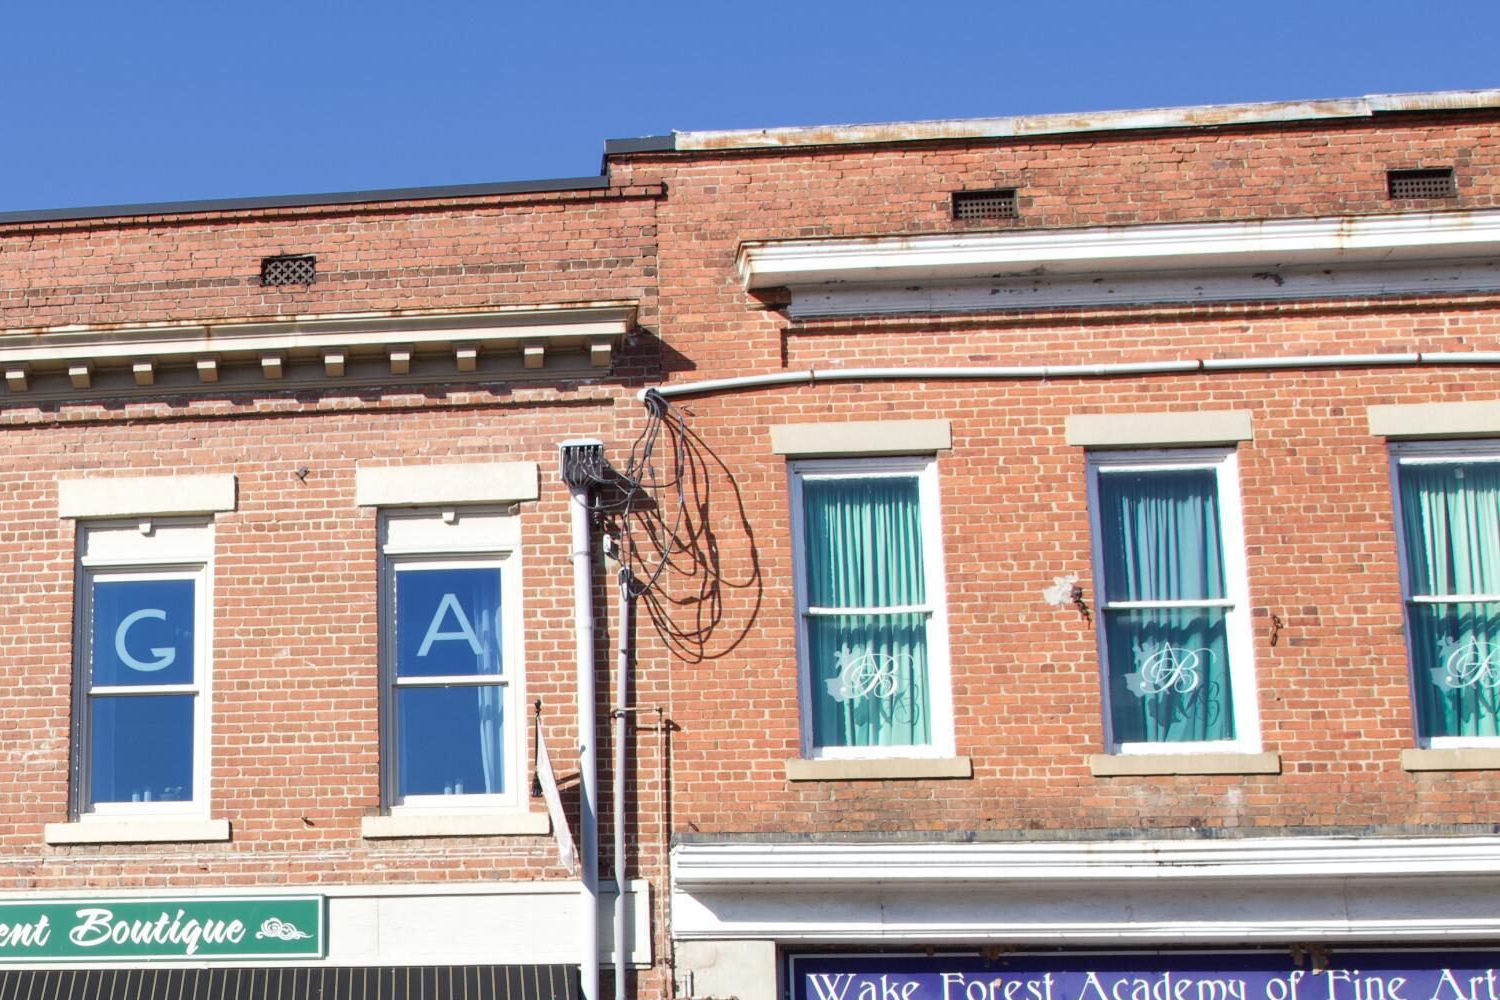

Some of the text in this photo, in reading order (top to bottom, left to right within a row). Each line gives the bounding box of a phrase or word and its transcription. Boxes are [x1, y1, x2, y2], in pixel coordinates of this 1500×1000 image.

[115, 608, 176, 672] G
[417, 592, 485, 656] A
[67, 908, 248, 956] Boutique
